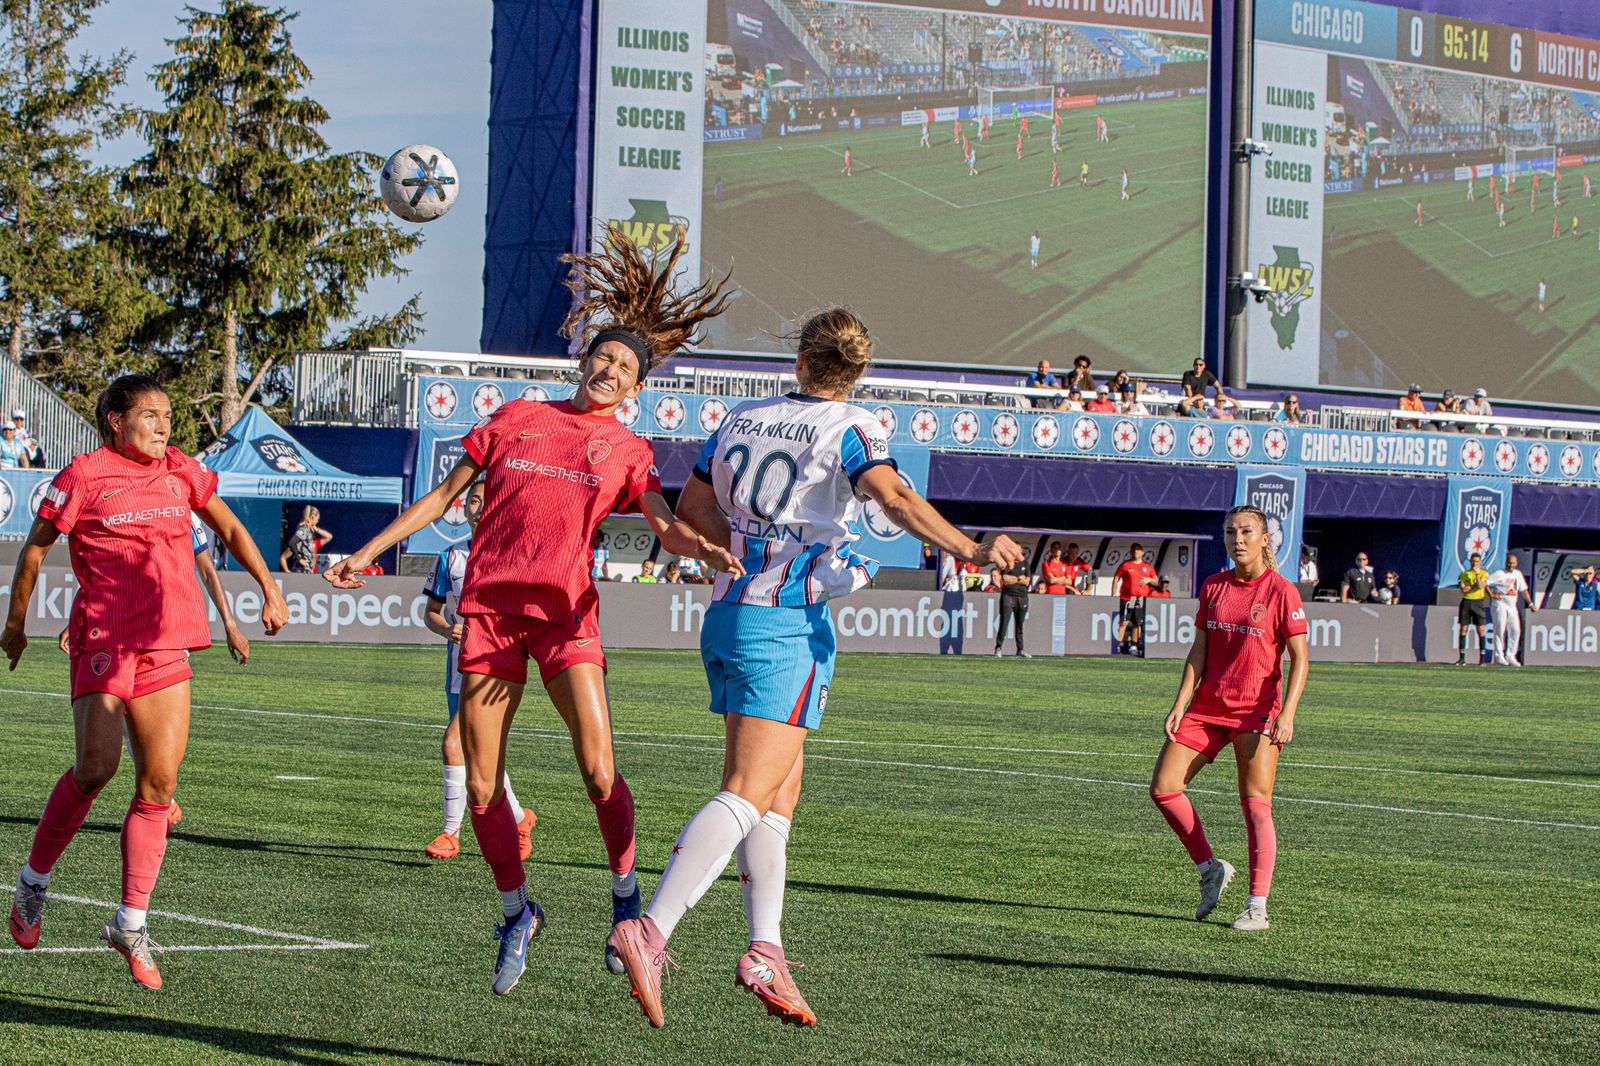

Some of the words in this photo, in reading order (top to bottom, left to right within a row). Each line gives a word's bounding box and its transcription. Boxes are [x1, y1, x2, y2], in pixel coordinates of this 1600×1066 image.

[617, 27, 690, 53] ILLINOIS
[1292, 1, 1364, 44] CHICAGO
[1410, 16, 1423, 57] 0
[1443, 24, 1489, 63] 95:14
[1509, 32, 1522, 73] 6
[1537, 41, 1584, 79] NORTH
[611, 66, 694, 93] WOMEN'S
[1266, 86, 1316, 111] ILLINOIS
[616, 105, 686, 131] SOCCER
[704, 128, 746, 139] NTRUST
[1261, 122, 1318, 148] WOMEN'S
[618, 146, 681, 170] LEAGUE
[1265, 160, 1312, 183] SOCCER
[1266, 196, 1309, 220] LEAGUE
[729, 418, 817, 444] FRANKLIN
[260, 444, 300, 461] STARS
[1301, 432, 1374, 464] CHICAGO
[1376, 436, 1425, 465] STARS
[1427, 438, 1448, 467] FC
[257, 478, 308, 498] CHICAGO
[311, 480, 345, 500] STARS
[349, 482, 363, 500] FC
[723, 442, 800, 522] 20
[1252, 492, 1289, 521] STARS
[1463, 503, 1498, 529] STARS
[730, 518, 804, 543] SLOAN
[670, 590, 707, 632] th
[837, 596, 979, 639] comfort
[1529, 615, 1598, 653] nella
